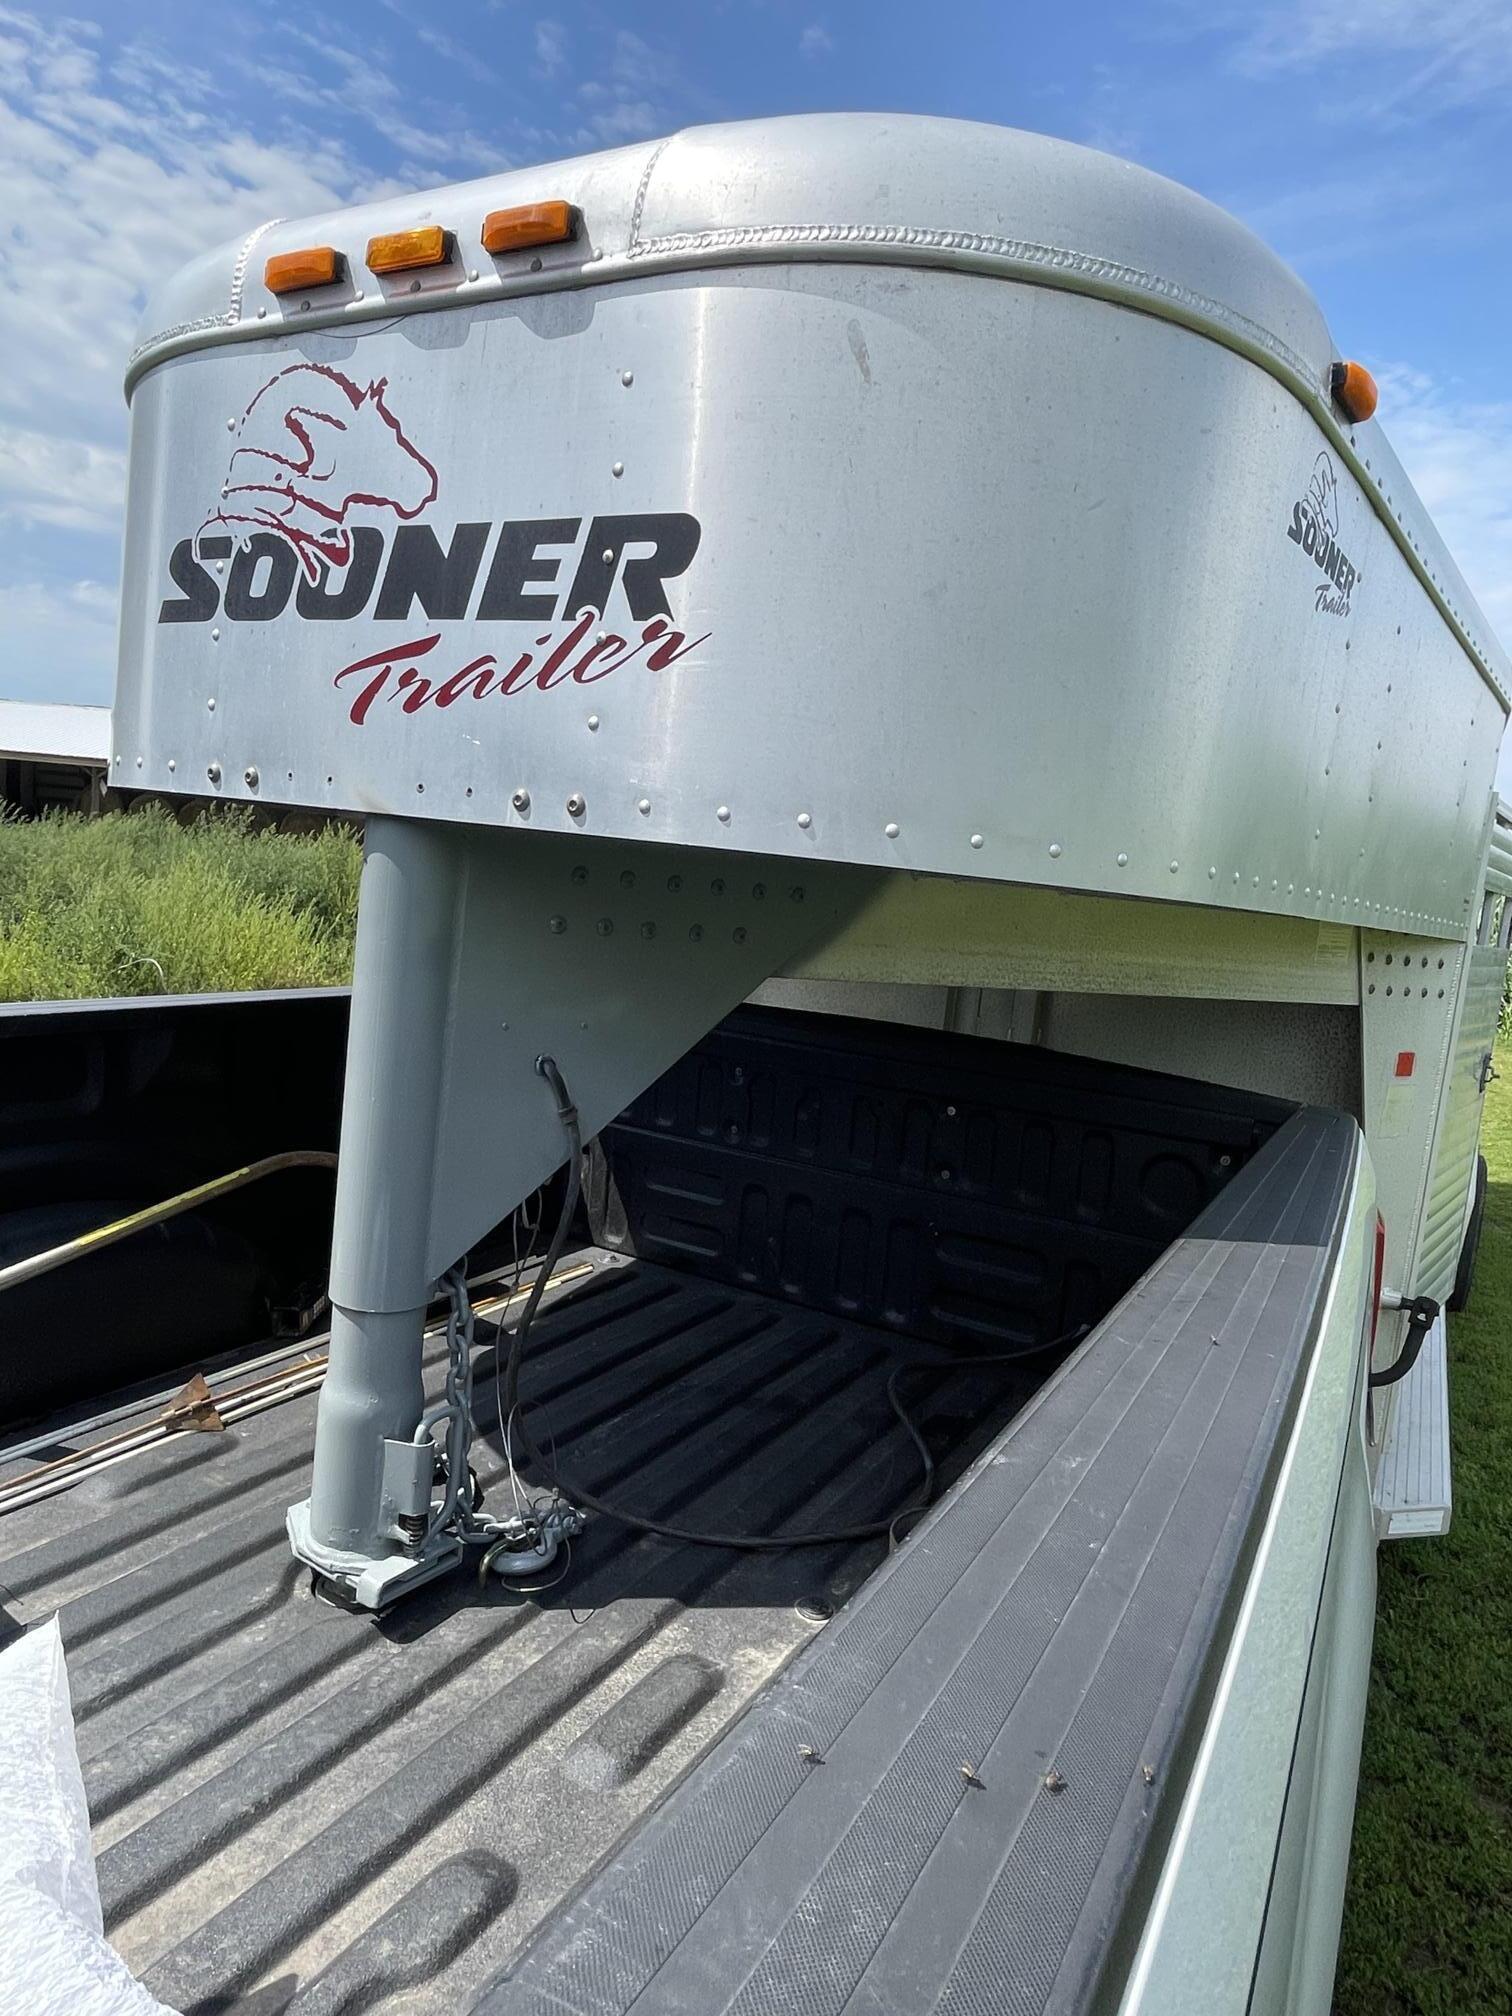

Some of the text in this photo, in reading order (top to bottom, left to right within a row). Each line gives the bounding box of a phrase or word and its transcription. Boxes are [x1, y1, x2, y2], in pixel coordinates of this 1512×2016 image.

[157, 512, 702, 624] SOONER
[1287, 501, 1357, 599] SOONER
[1314, 583, 1352, 618] Trailer
[333, 612, 712, 726] Trailer
